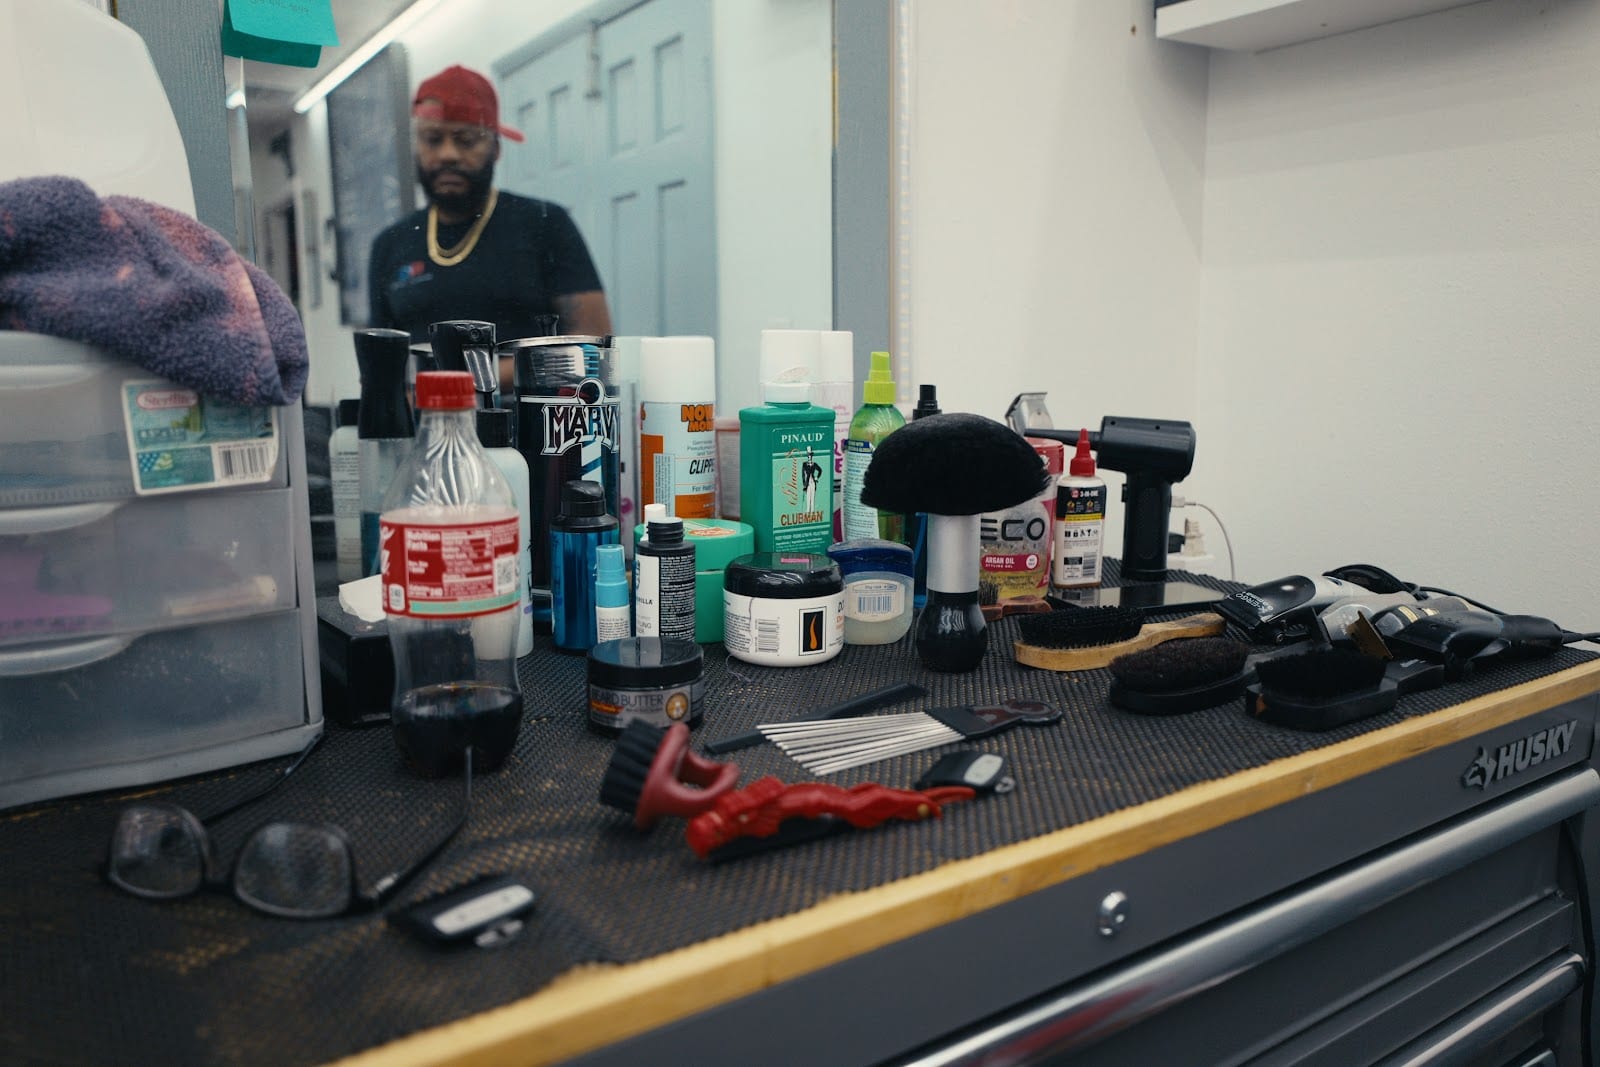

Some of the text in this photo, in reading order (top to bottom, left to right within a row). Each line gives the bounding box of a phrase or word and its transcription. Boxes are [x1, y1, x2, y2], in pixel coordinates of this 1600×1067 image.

[781, 433, 822, 443] PINAUD
[781, 511, 823, 526] CLUBMAN
[980, 517, 1046, 541] ECO
[985, 556, 1015, 565] ARGAN OIL
[620, 694, 664, 707] BUTTER
[1496, 720, 1578, 780] HUSKY
